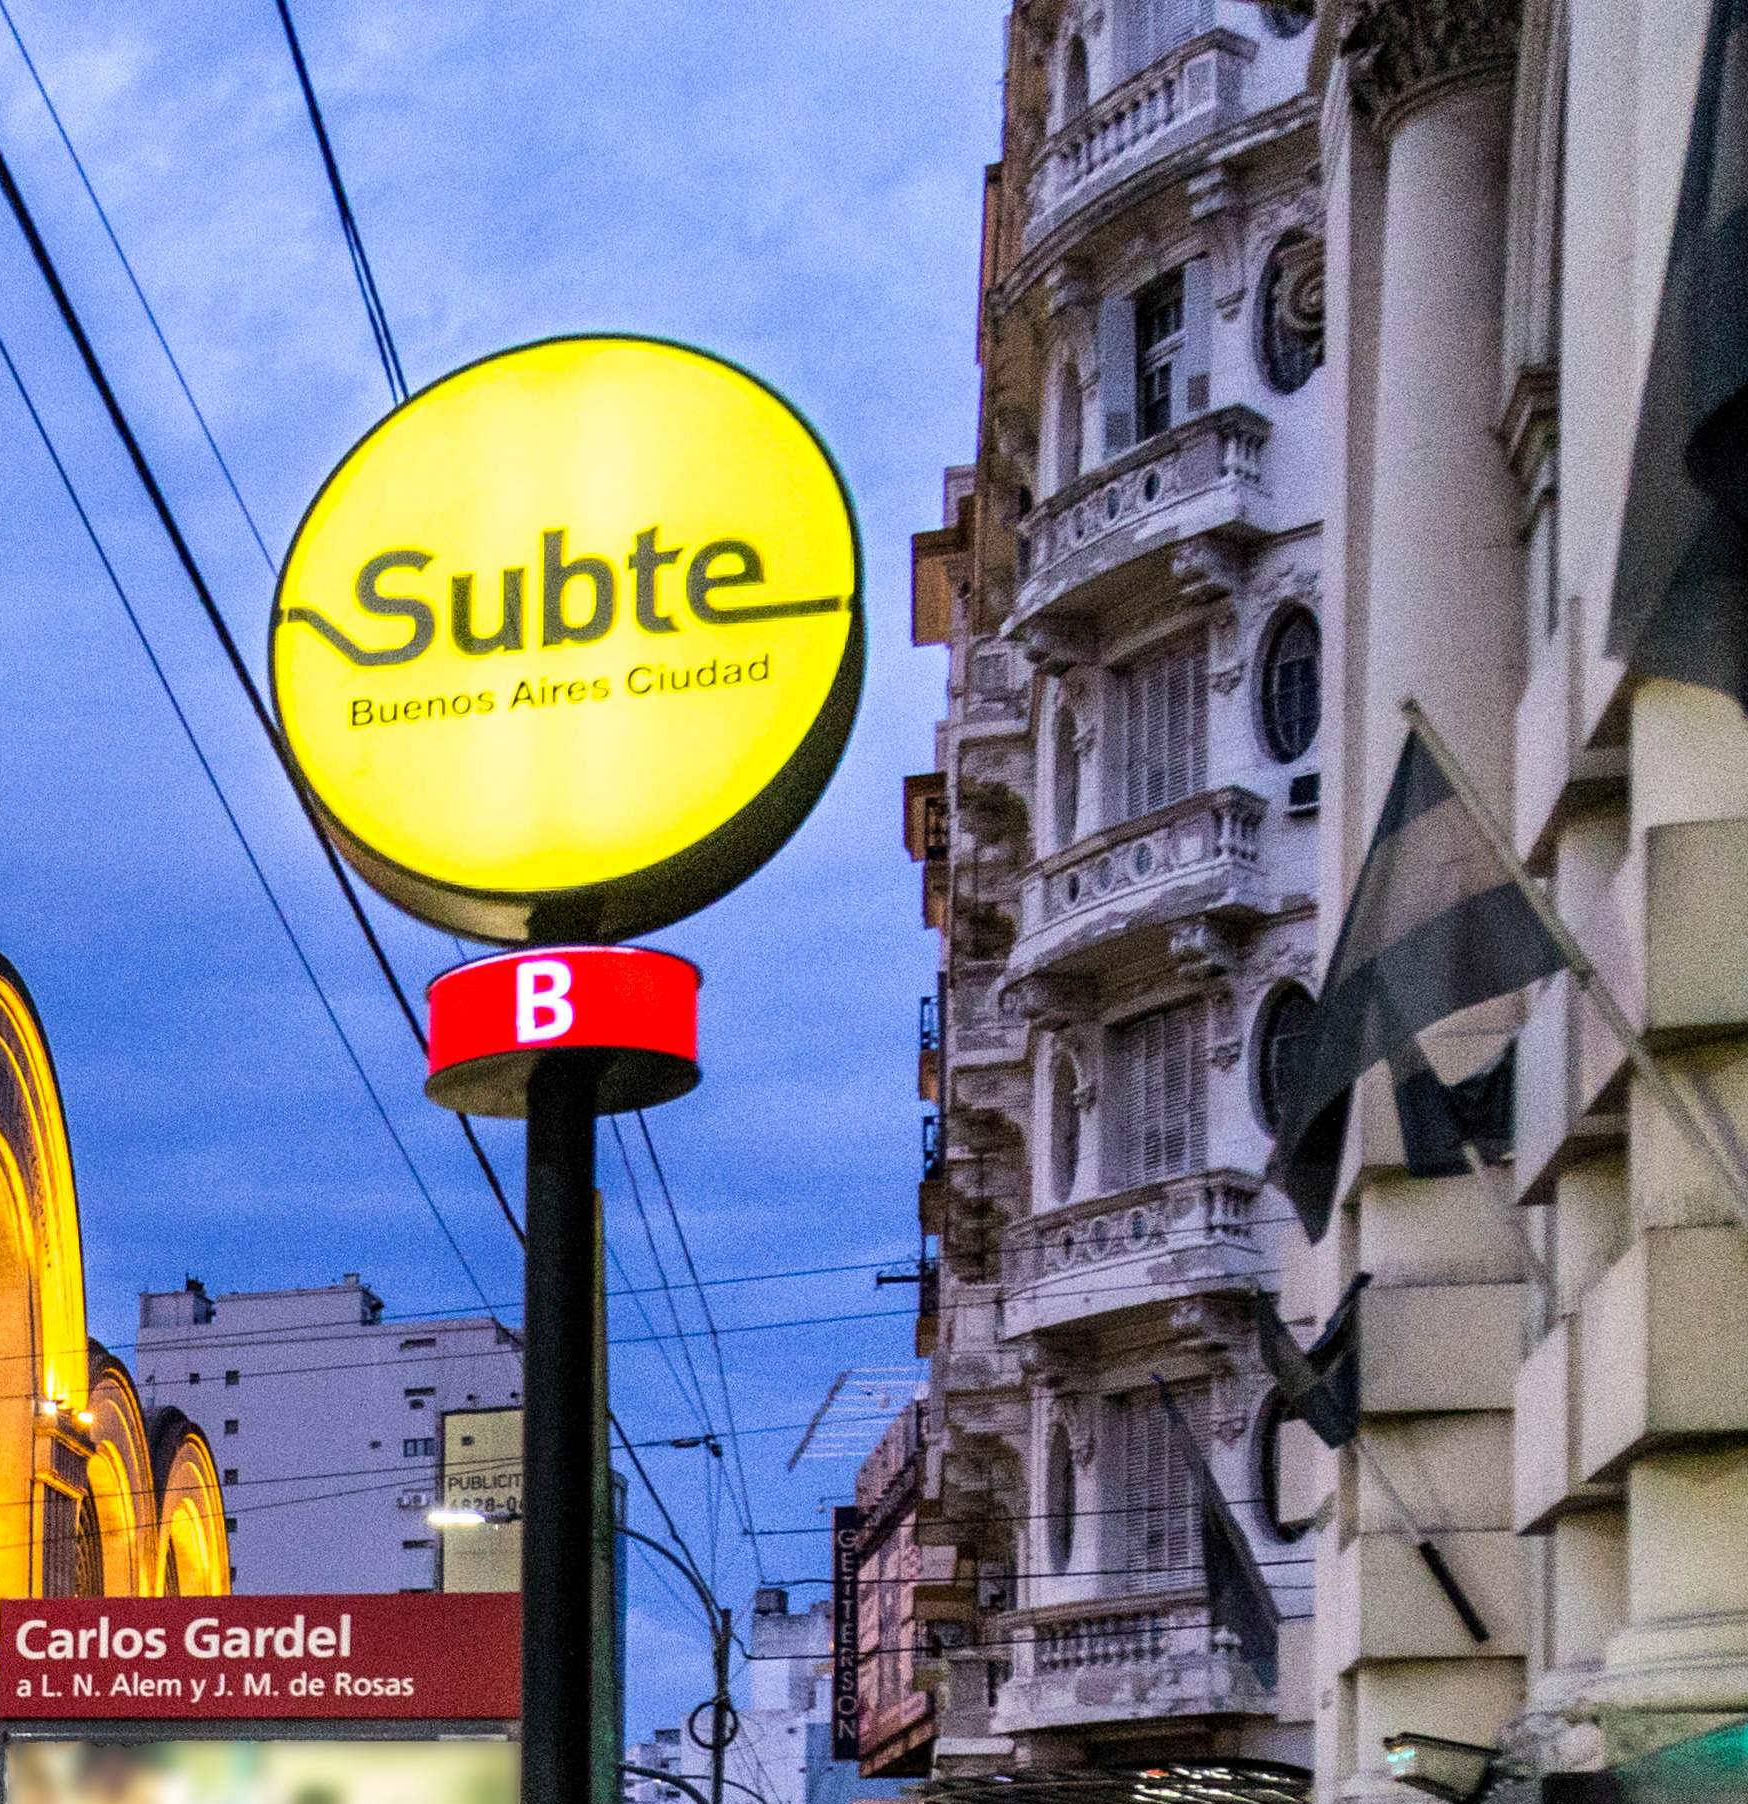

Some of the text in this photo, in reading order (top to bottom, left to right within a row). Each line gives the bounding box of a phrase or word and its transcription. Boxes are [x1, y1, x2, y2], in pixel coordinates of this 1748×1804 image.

[287, 526, 842, 667] Subte
[351, 653, 770, 728] Buenos Aires Ciudad
[516, 960, 575, 1043] B
[15, 1613, 352, 1660] Carlos Gardel
[837, 1528, 858, 1740] GETTERSON
[16, 1672, 414, 1703] a L. N. Alem y J. M. de Rosas
